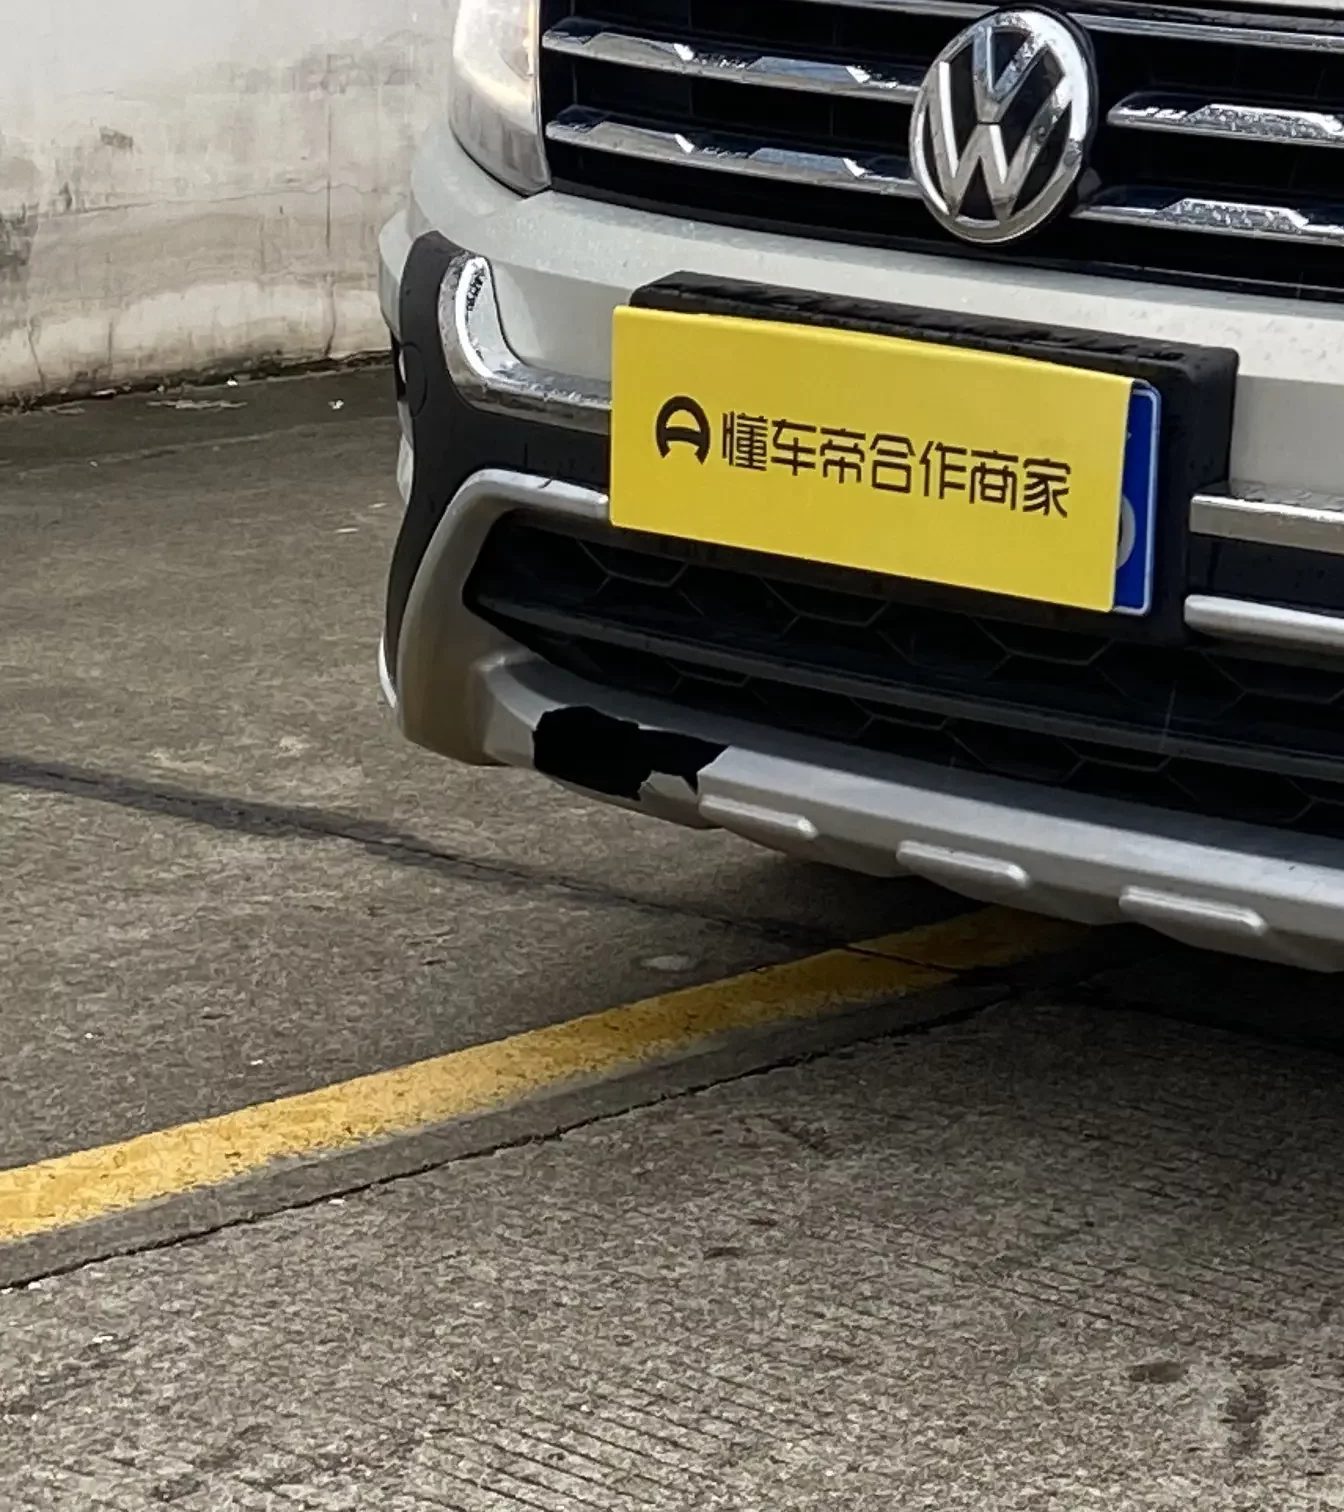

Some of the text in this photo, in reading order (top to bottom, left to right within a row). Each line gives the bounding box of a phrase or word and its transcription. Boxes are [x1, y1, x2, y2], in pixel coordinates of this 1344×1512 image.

[912, 10, 1088, 241] VW
[721, 409, 1072, 520] 懂车帝合作商家
